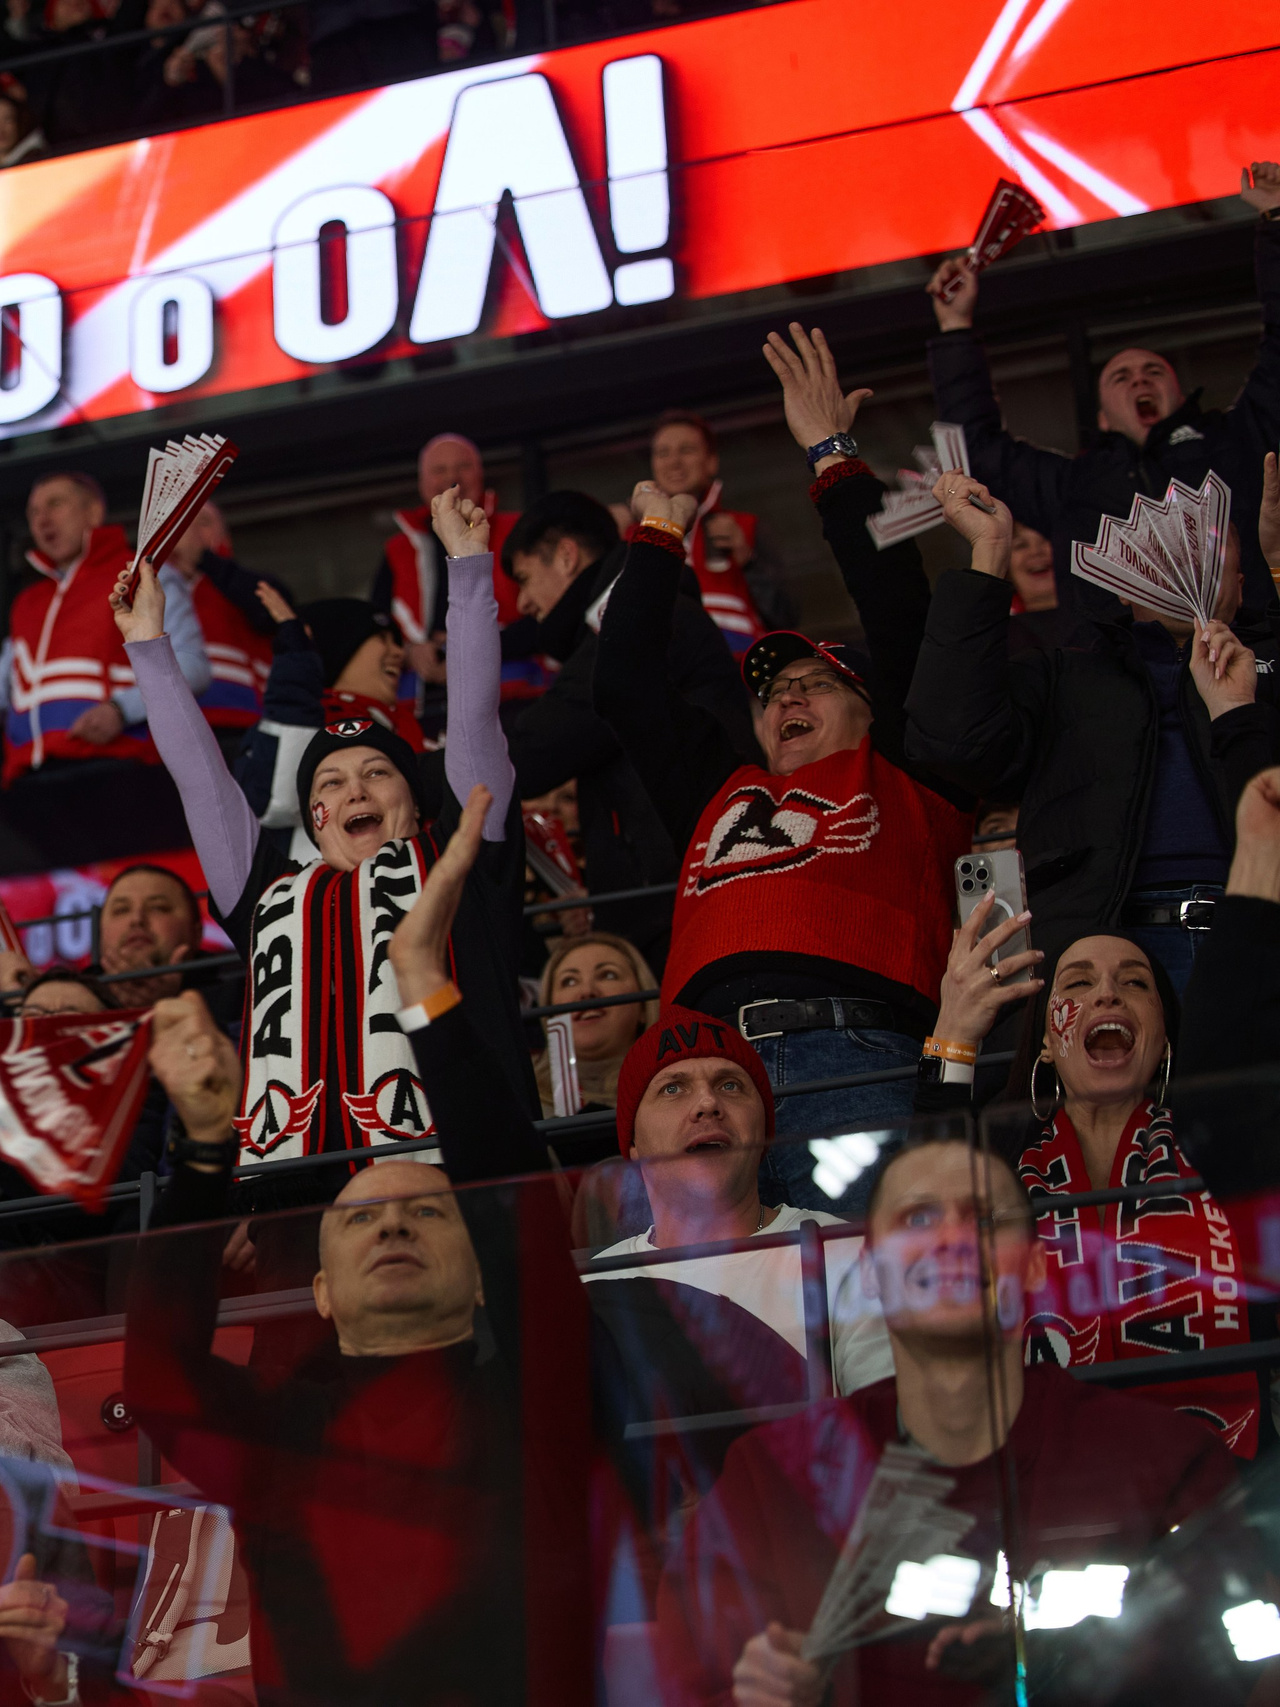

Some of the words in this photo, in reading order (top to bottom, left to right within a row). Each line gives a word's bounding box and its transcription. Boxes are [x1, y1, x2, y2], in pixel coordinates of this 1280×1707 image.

[1119, 538, 1158, 585] ТОЛЬКО
[656, 1021, 726, 1061] AVT
[1200, 1191, 1240, 1330] HOCKE
[113, 1403, 125, 1419] 6
